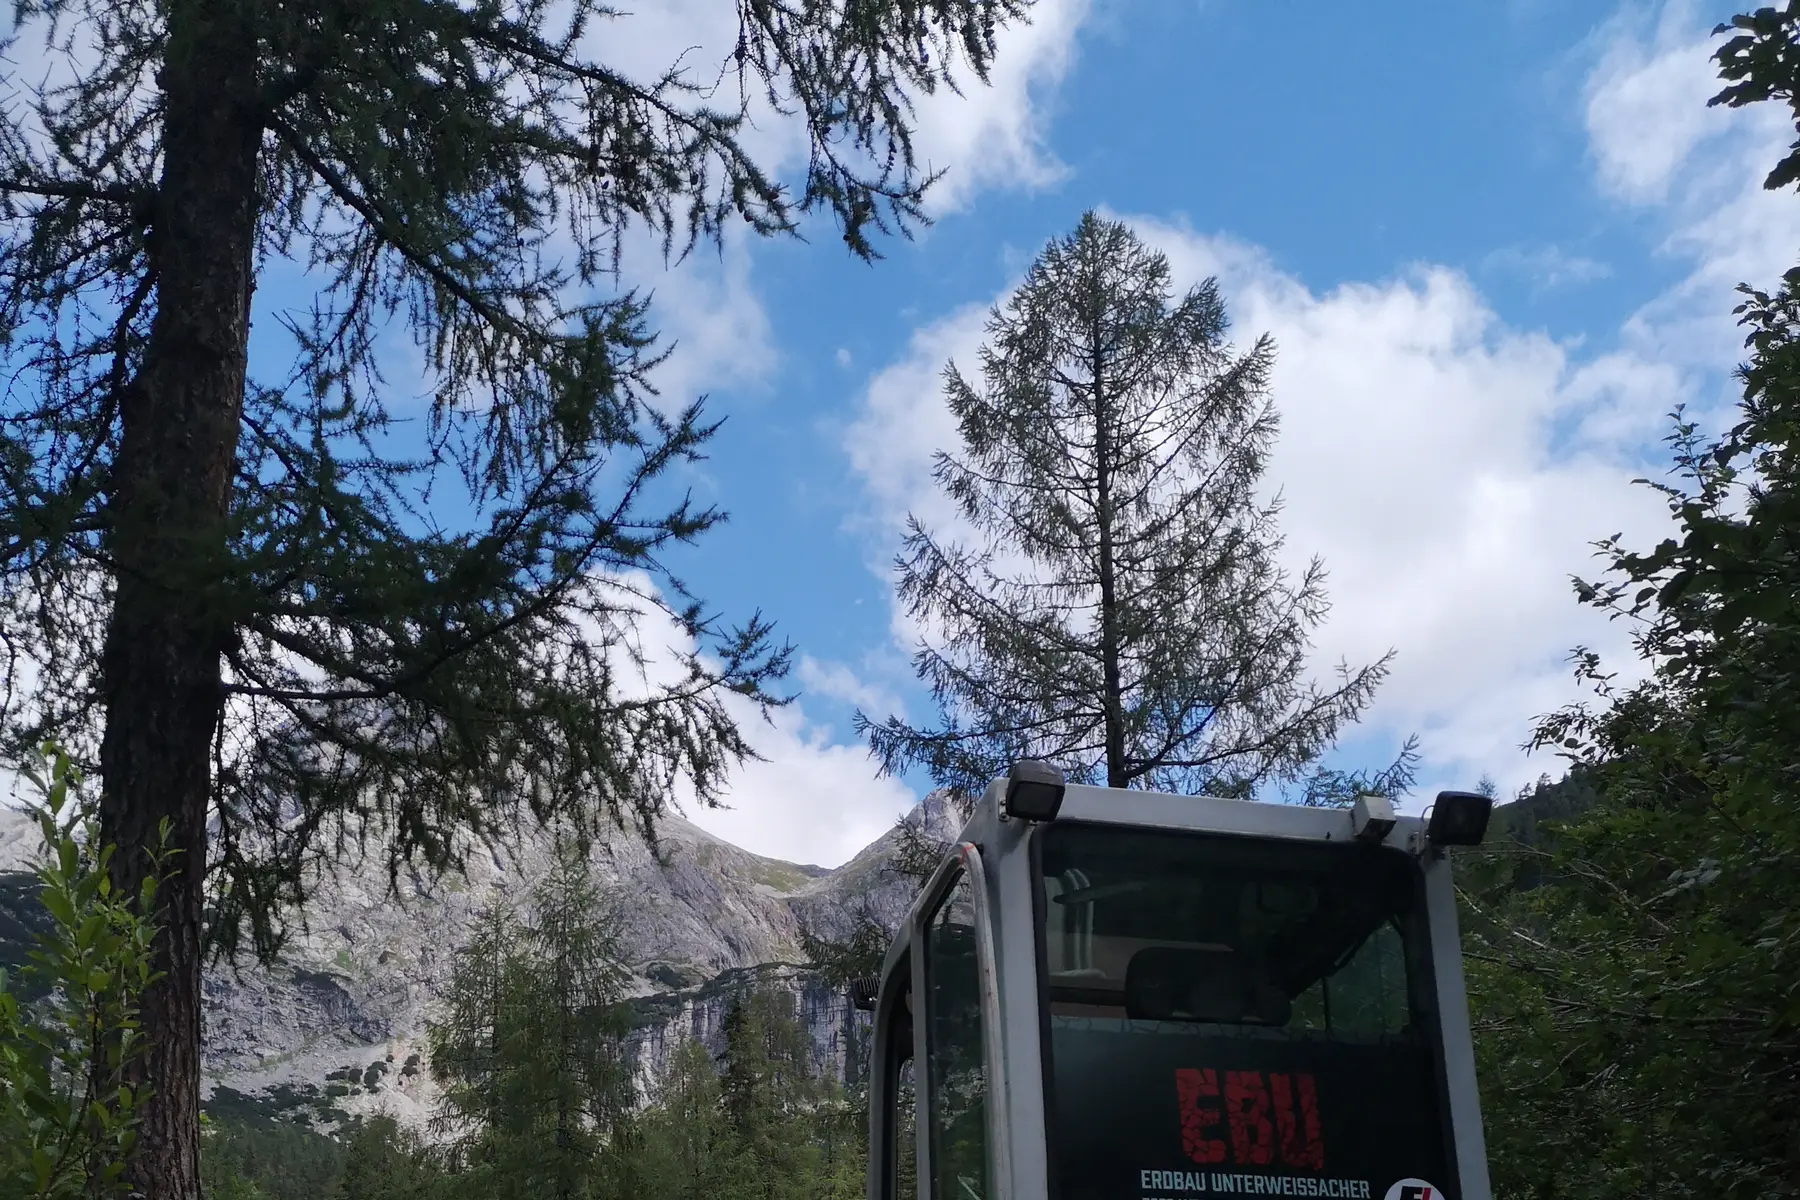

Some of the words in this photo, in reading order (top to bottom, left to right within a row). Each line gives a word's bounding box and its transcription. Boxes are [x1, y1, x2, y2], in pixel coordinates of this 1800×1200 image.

[1175, 1067, 1325, 1171] EBU
[1140, 1169, 1206, 1192] ERDBAU
[1211, 1172, 1371, 1199] UNTERWEISSACHER
